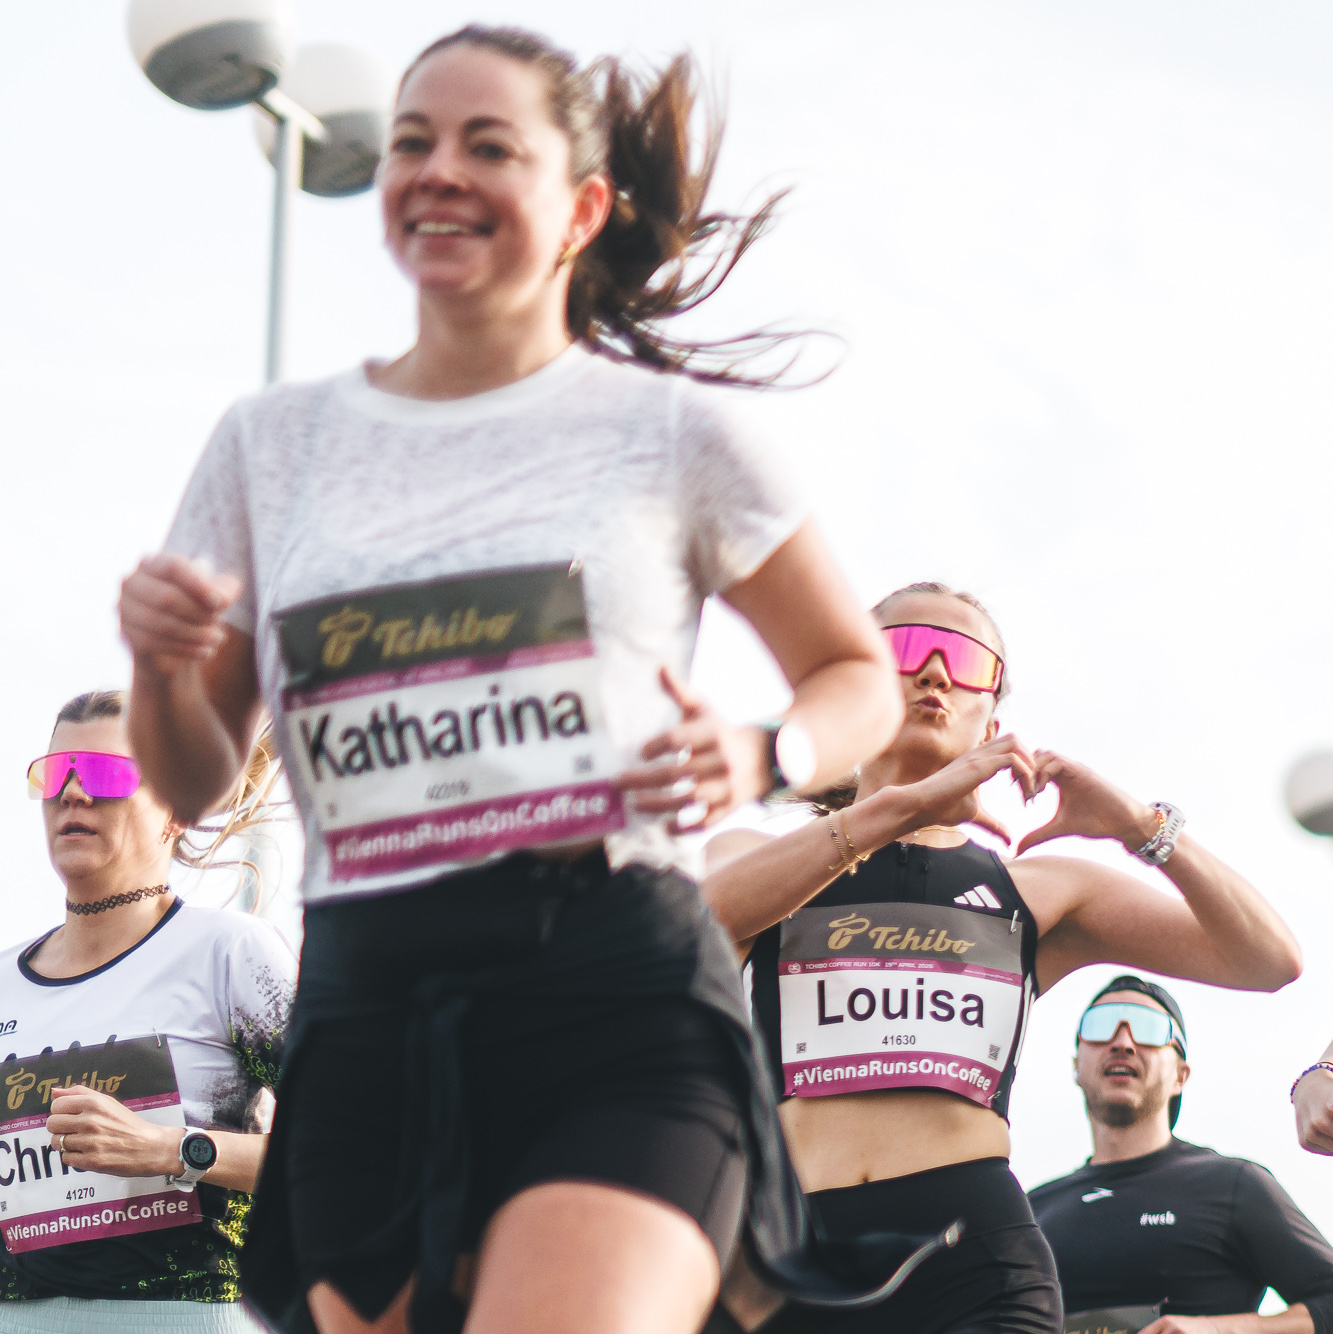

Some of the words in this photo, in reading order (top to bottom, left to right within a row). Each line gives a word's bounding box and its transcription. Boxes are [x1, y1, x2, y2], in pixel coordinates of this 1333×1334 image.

[373, 607, 519, 658] Tchibo
[299, 684, 588, 782] Katharina
[336, 793, 607, 861] #ViennaRunsOnCoffee
[869, 927, 976, 954] Tchibo
[817, 978, 984, 1028] Louisa
[882, 1034, 916, 1046] 41630
[793, 1058, 992, 1091] #ViennaRunsOnCoffee
[66, 1187, 95, 1202] 41270
[6, 1200, 189, 1242] #ViennaRunsOnCoffee
[1140, 1211, 1175, 1226] #wsb
